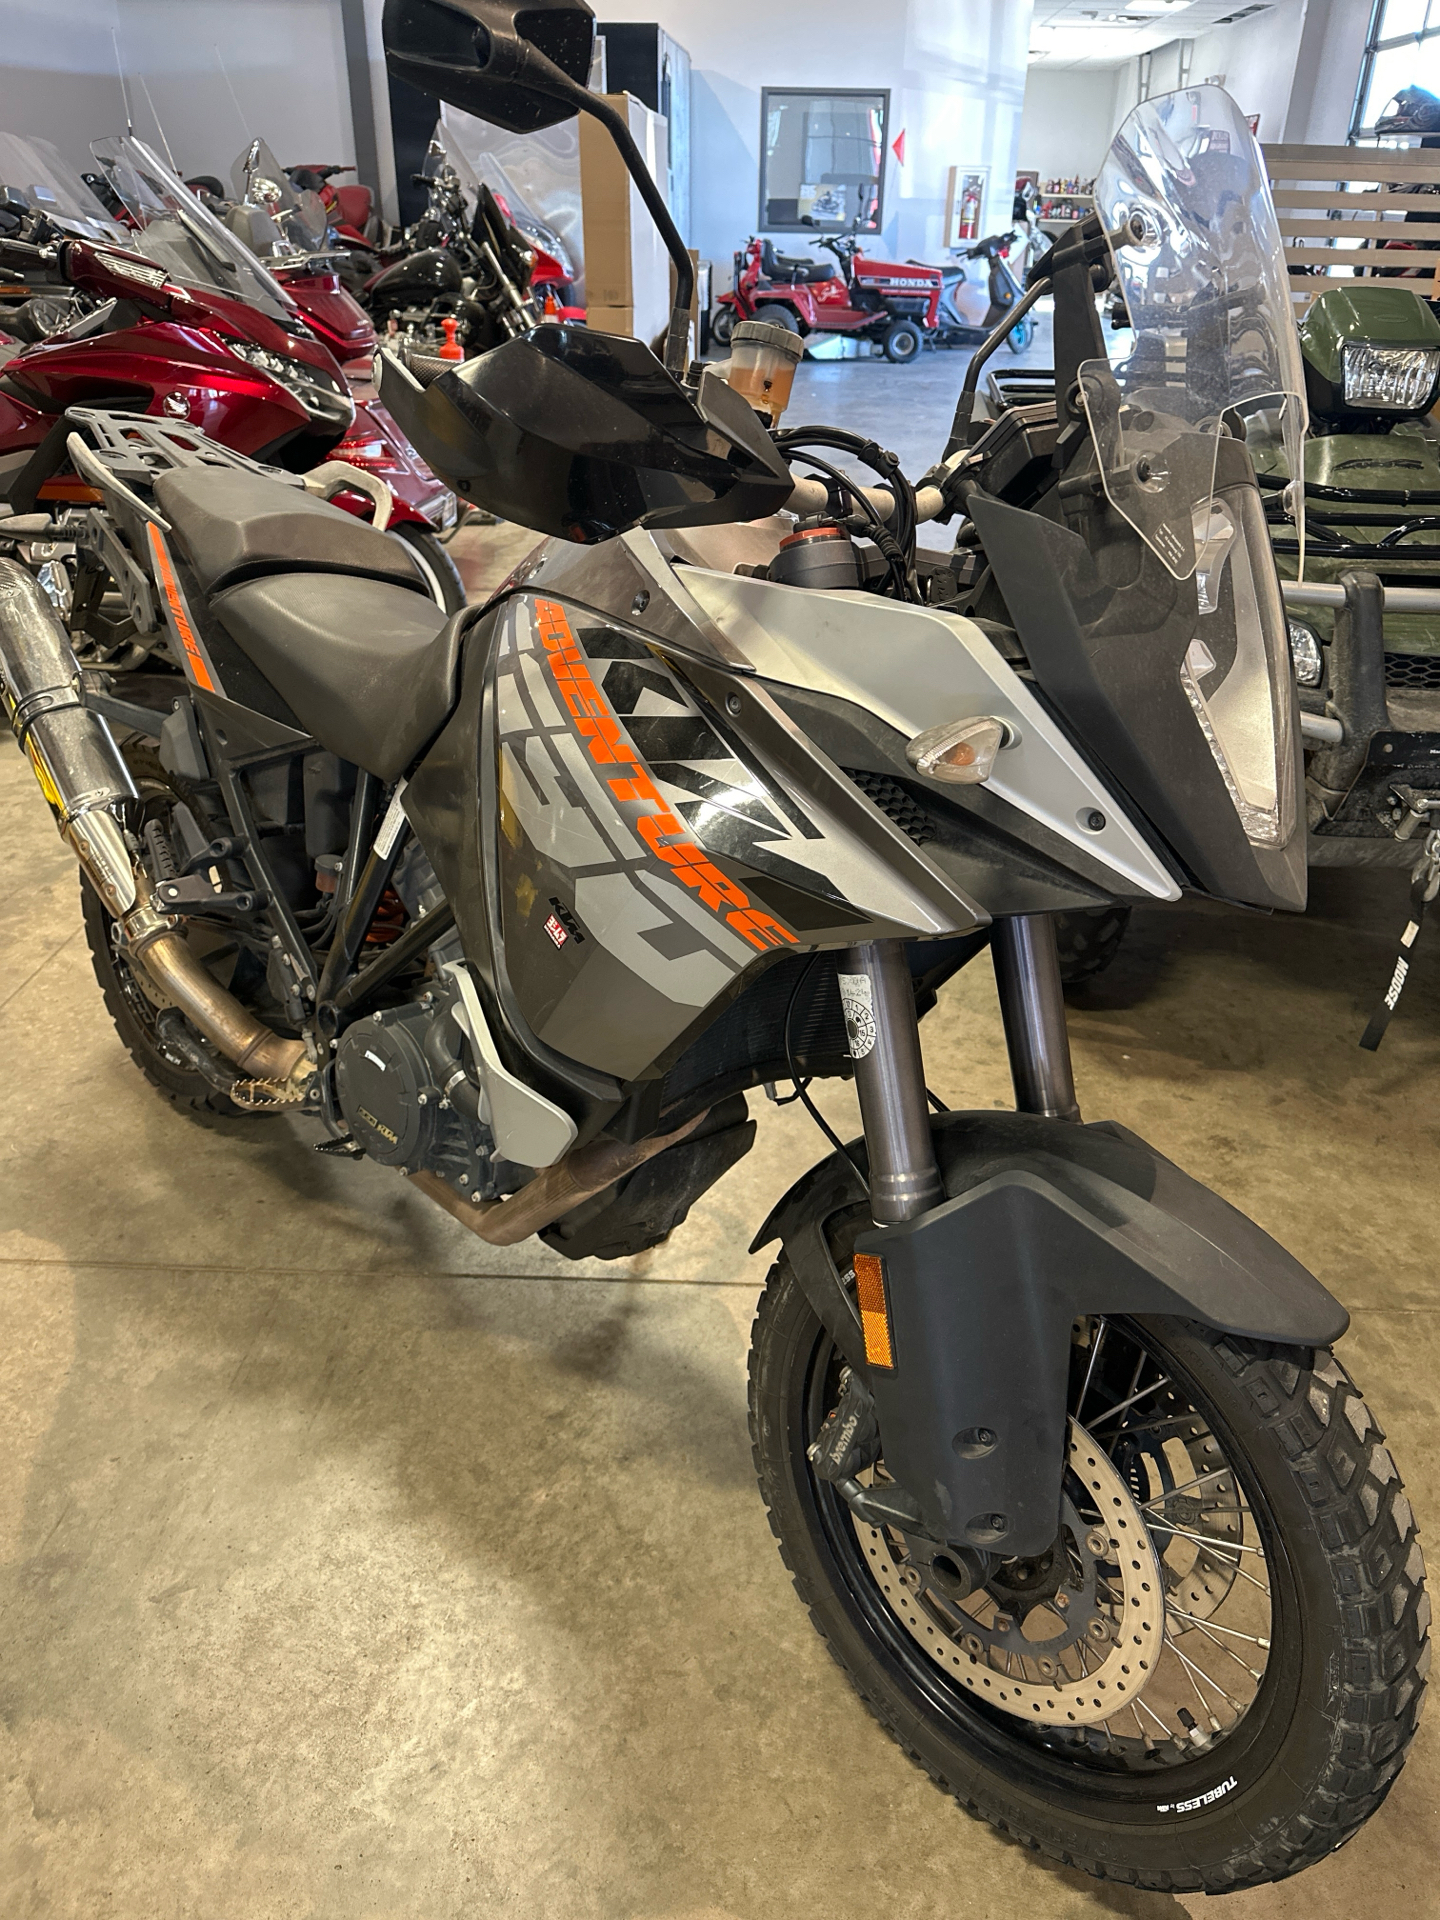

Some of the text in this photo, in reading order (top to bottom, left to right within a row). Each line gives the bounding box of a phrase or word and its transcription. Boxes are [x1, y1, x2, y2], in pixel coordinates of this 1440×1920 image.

[889, 277, 933, 287] HONDA
[534, 598, 800, 951] ADVENTURE
[576, 626, 873, 931] KTM
[549, 896, 585, 944] KTM
[1384, 955, 1410, 1011] MOOSE
[829, 1415, 858, 1466] brembo
[1176, 1775, 1238, 1814] TUBELESS
